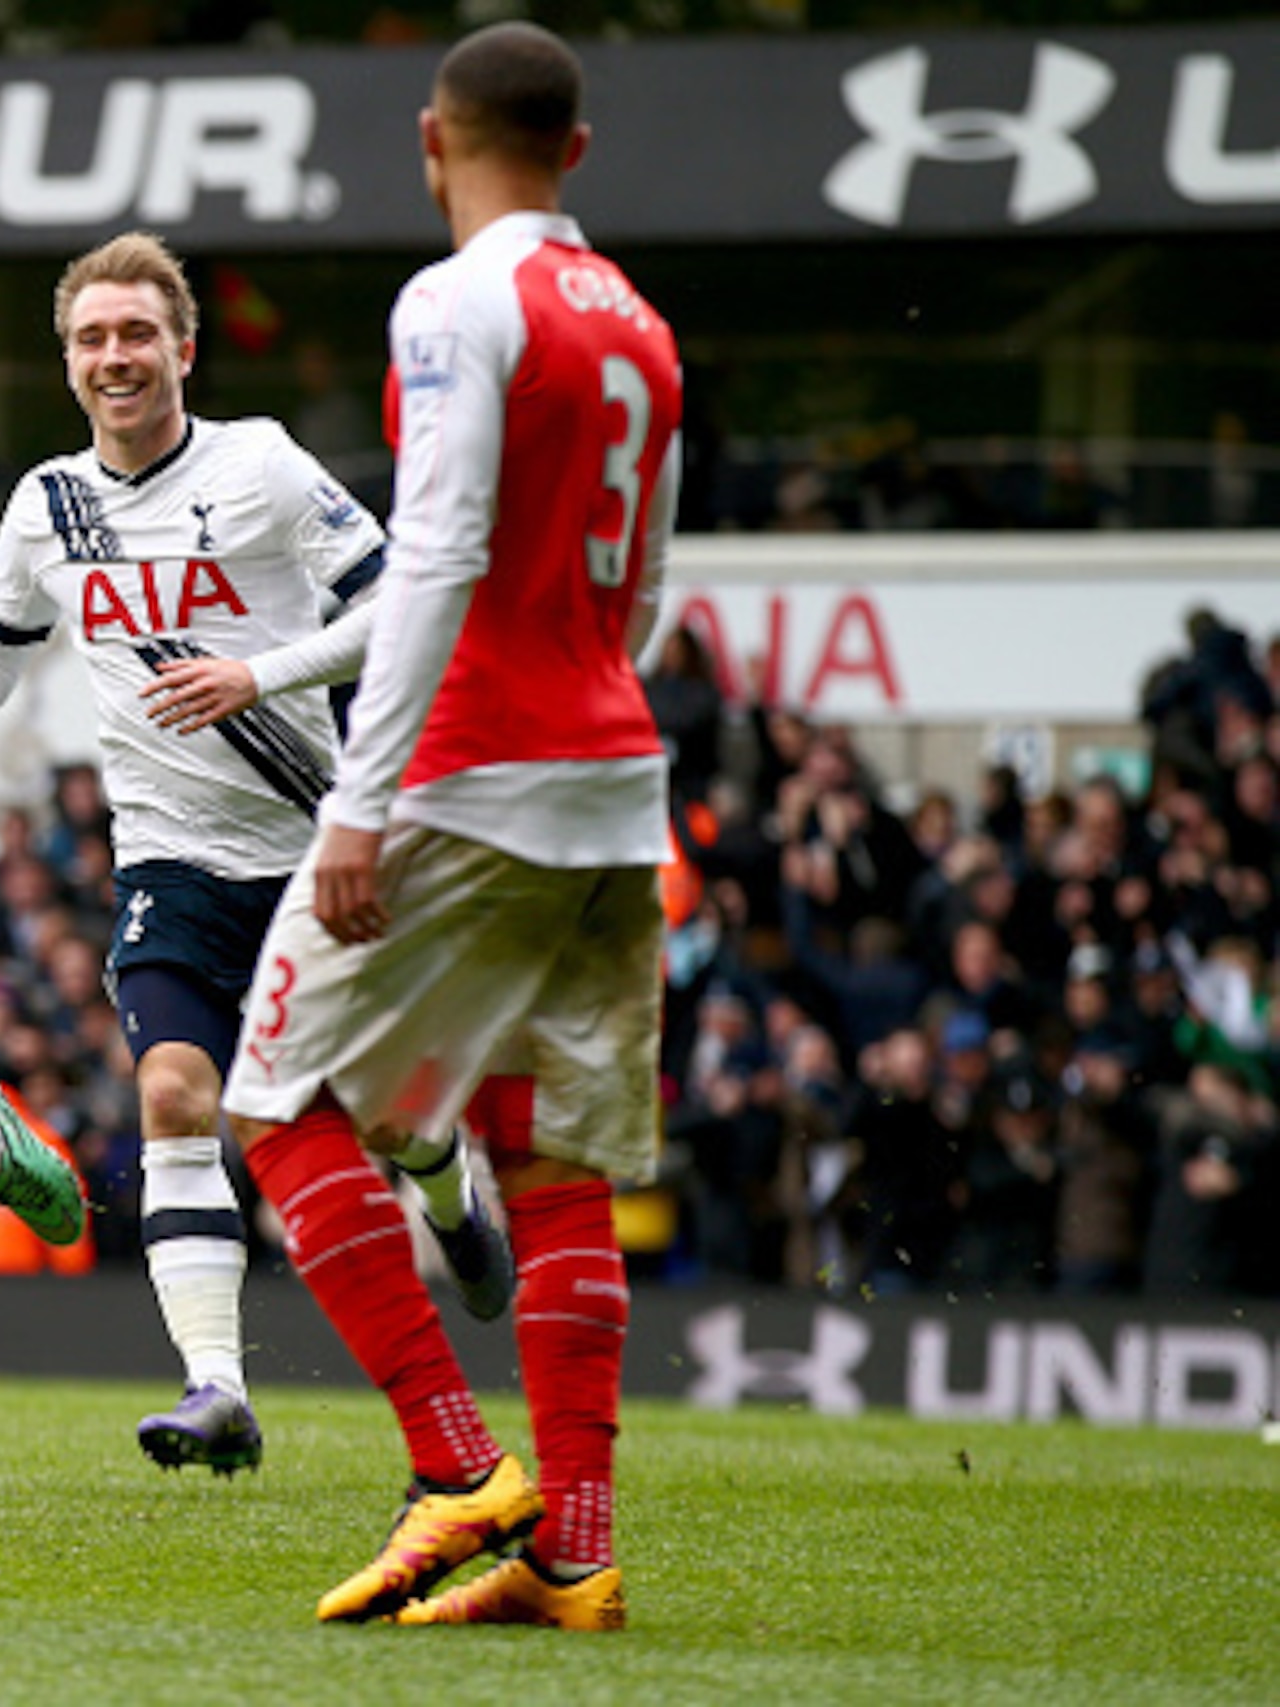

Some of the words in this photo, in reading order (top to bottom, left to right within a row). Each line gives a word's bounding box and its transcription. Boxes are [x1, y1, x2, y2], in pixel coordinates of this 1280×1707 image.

[585, 354, 651, 587] 3
[82, 558, 249, 643] AIA
[256, 955, 297, 1041] 3
[907, 1319, 1280, 1429] UND
